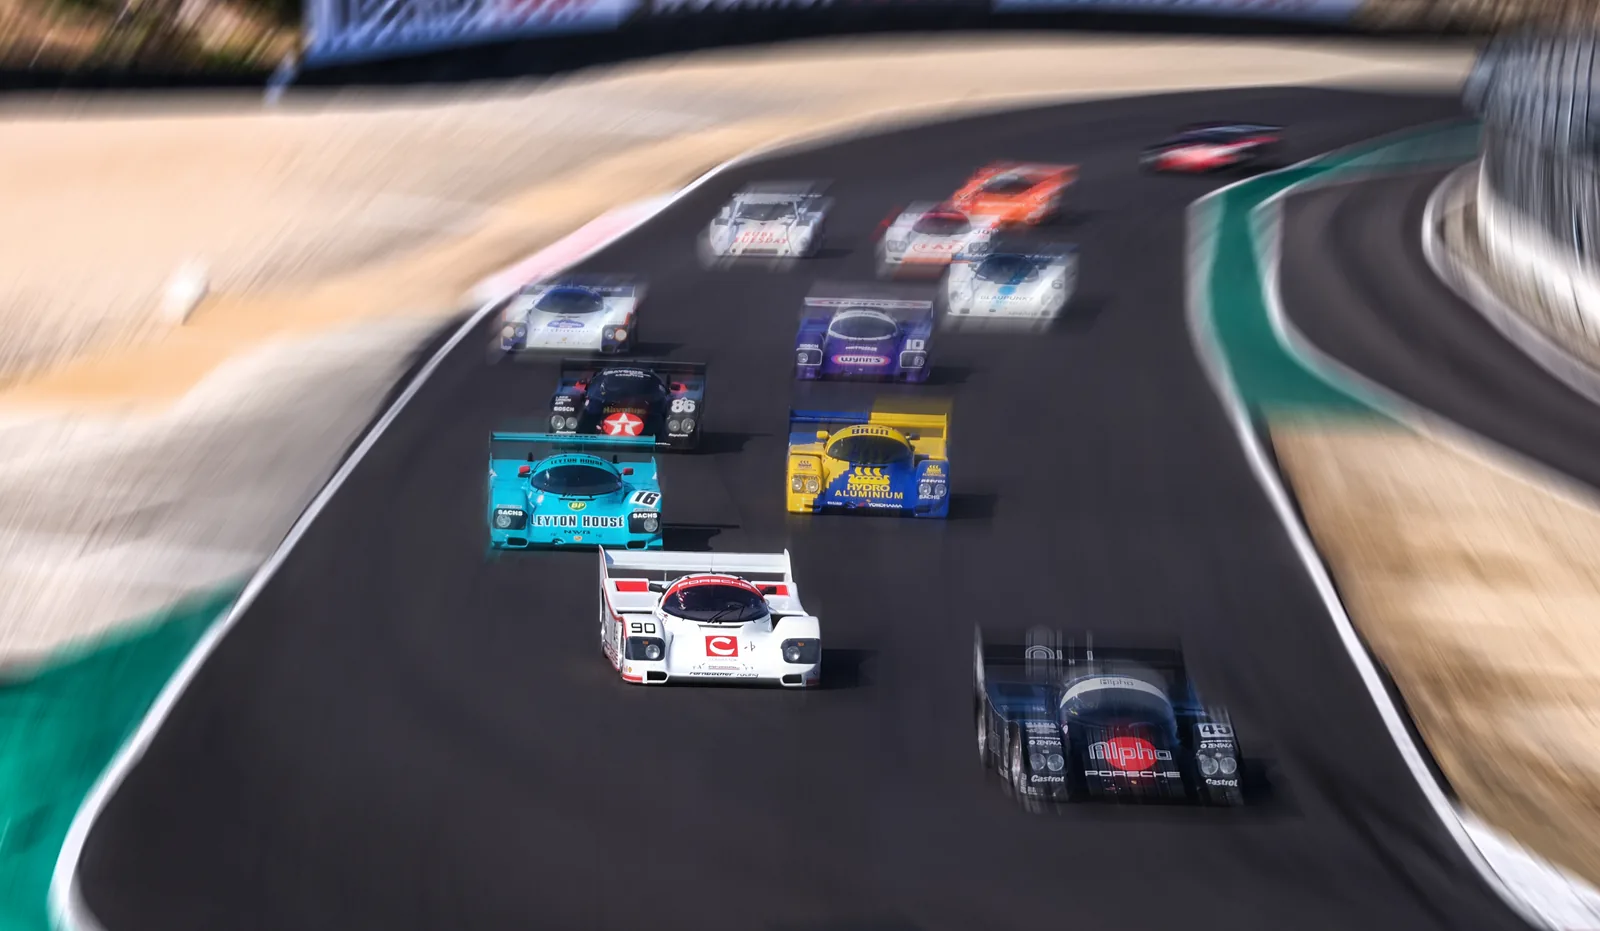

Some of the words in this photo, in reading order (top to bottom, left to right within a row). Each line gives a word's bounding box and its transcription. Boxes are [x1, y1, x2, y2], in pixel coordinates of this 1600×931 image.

[906, 339, 925, 350] 10
[671, 399, 696, 413] 86
[847, 483, 890, 492] HYDRO
[635, 491, 660, 506] 16
[834, 489, 904, 500] ALUMINIUM
[571, 501, 585, 509] BP
[497, 509, 524, 517] SACHS
[531, 514, 578, 527] LEYTON
[582, 515, 625, 528] HOUSE
[677, 579, 753, 590] PORSCHE
[630, 622, 656, 634] 90
[1201, 723, 1232, 735] 45
[1088, 741, 1173, 767] Alpha
[1030, 774, 1065, 783] Castrol
[1084, 770, 1181, 778] PORSCHE
[1205, 778, 1239, 787] Castrol
